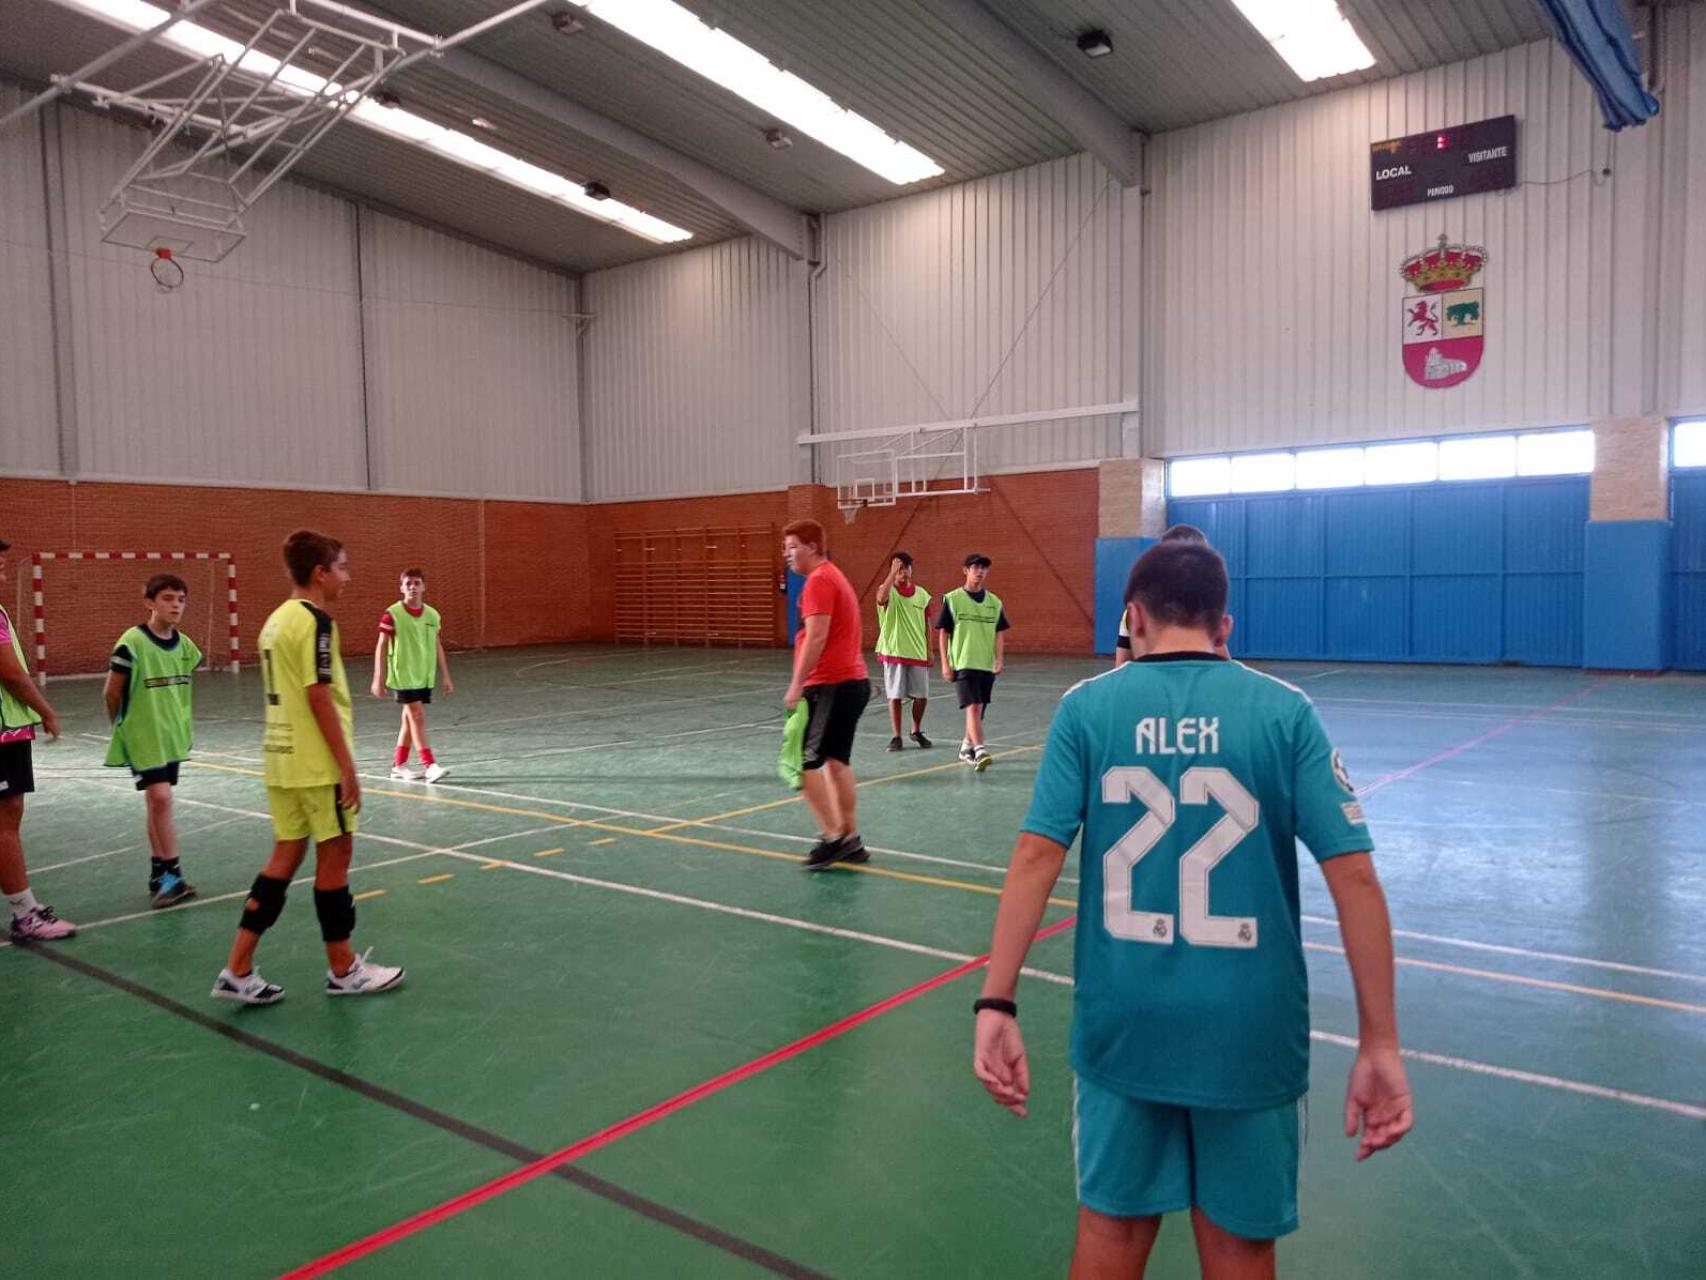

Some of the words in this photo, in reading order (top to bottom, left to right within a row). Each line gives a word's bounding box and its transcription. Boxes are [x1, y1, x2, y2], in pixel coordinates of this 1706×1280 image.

[1468, 146, 1508, 163] VISITANTE
[1375, 165, 1412, 181] LOCAL
[1135, 715, 1220, 755] ALEX
[1102, 766, 1260, 948] 22
